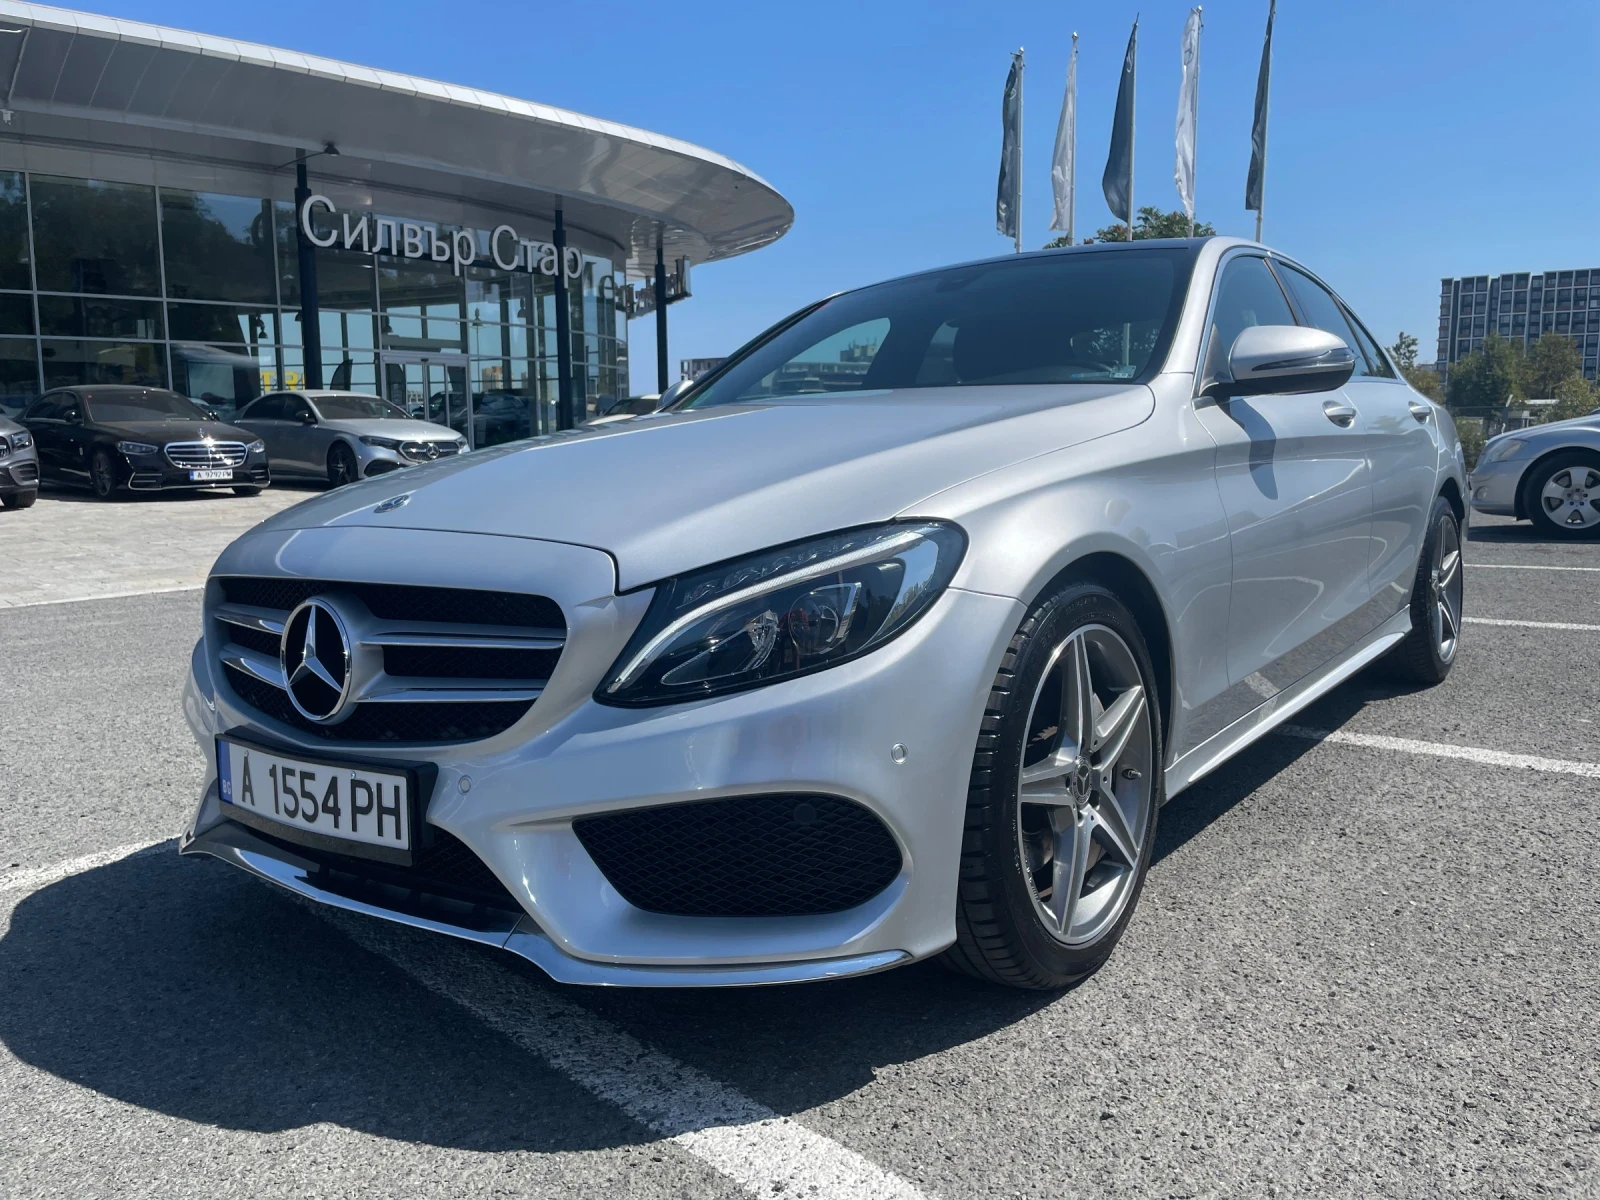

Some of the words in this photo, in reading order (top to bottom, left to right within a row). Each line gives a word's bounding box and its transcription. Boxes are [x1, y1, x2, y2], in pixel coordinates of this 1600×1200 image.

[302, 195, 476, 276] Силвър
[492, 225, 583, 288] Стар
[222, 778, 232, 795] BG
[242, 755, 256, 806] A
[269, 764, 342, 829] 1554
[350, 778, 402, 840] PH
